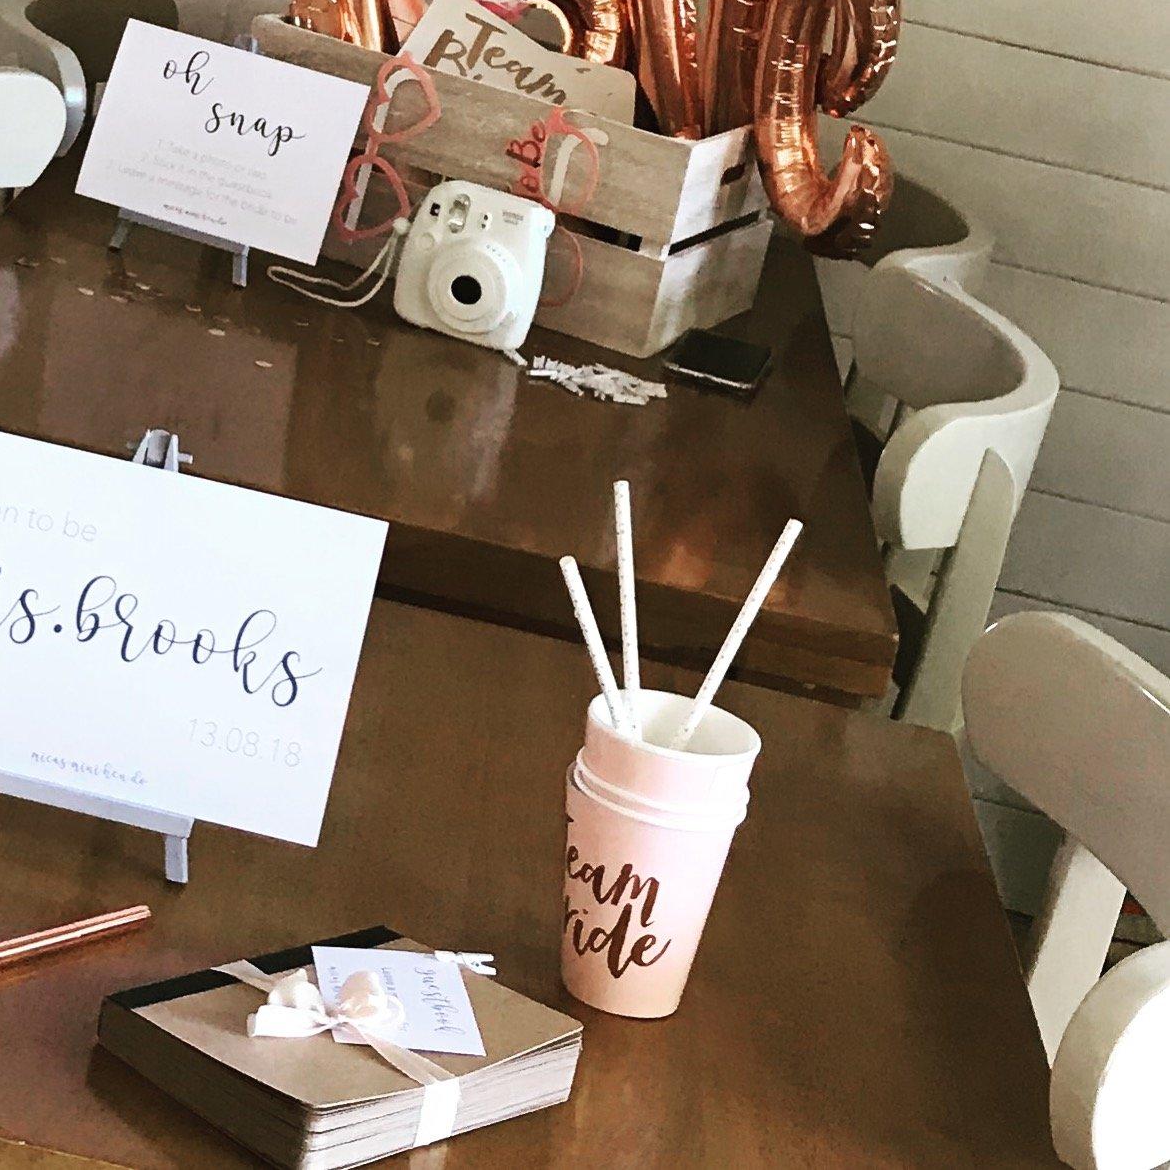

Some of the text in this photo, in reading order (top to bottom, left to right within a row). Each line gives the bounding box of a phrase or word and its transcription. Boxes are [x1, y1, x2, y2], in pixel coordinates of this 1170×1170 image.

[162, 50, 215, 96] oh
[465, 12, 567, 106] Team
[204, 102, 306, 157] snap
[28, 505, 55, 533] to
[62, 513, 99, 543] be
[186, 717, 303, 768] 13.08.18
[567, 844, 660, 928] eam
[565, 902, 672, 979] ride
